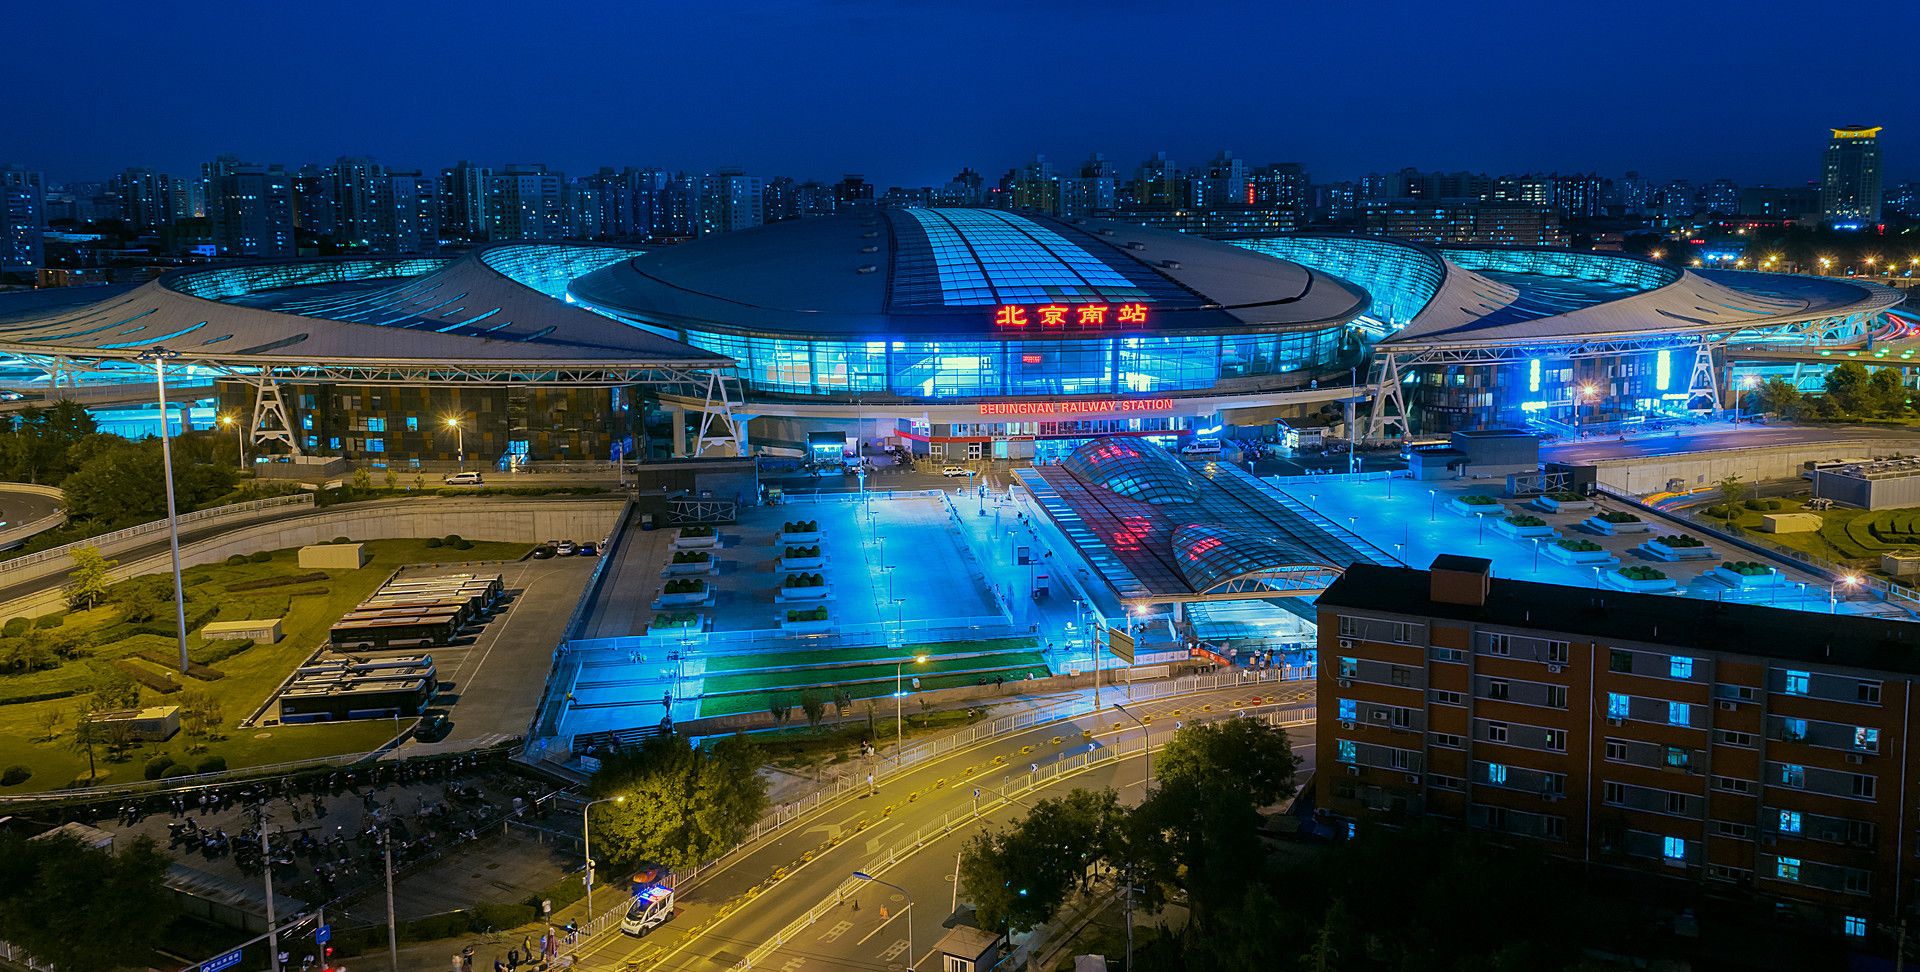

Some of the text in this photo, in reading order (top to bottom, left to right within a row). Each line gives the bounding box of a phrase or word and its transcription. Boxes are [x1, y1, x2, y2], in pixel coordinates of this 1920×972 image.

[996, 304, 1148, 325] 北京南站
[980, 399, 1173, 414] BEIJINGNAN RAILWAY STATION
